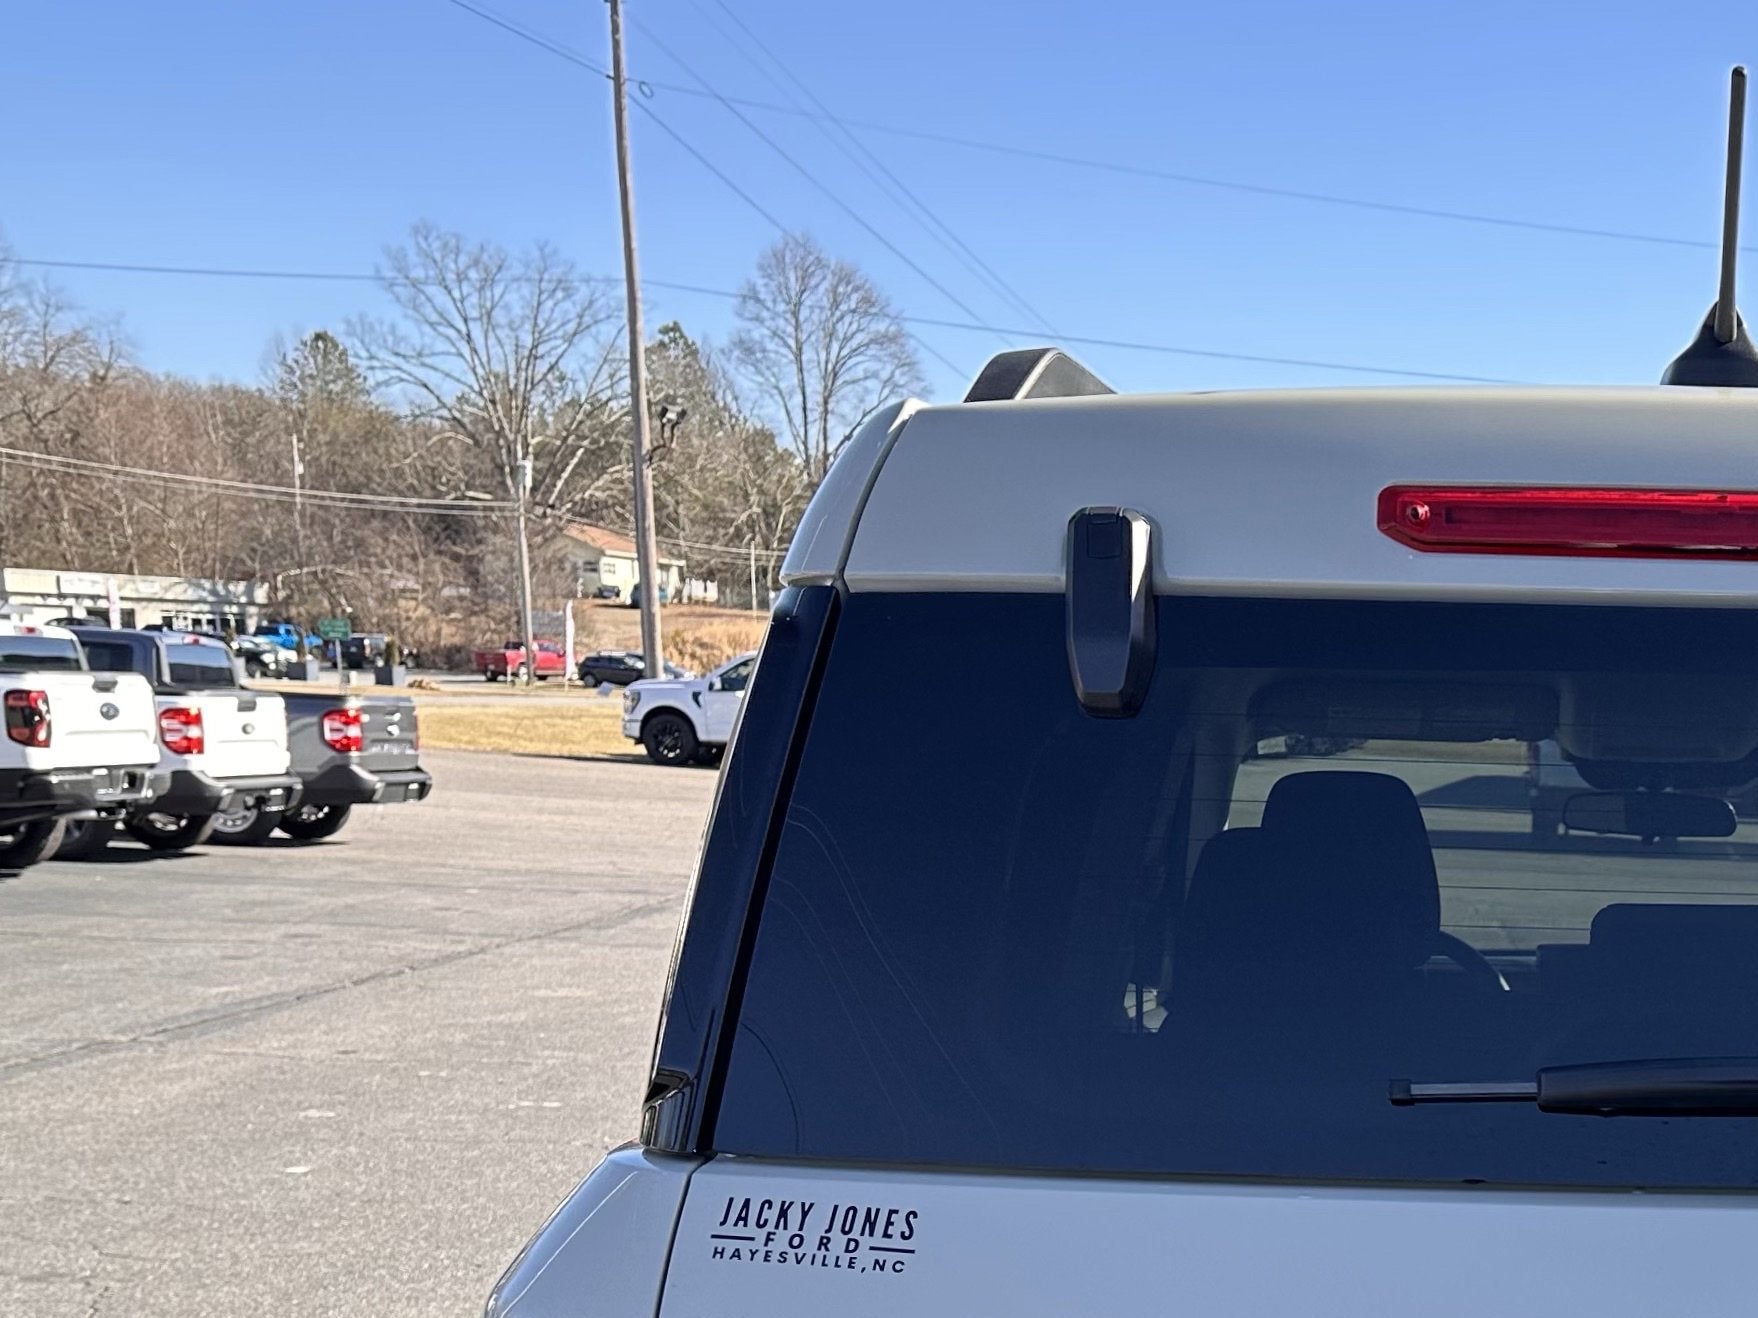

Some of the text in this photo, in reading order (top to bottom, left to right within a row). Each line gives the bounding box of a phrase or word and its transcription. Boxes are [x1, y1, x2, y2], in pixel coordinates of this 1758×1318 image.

[718, 1196, 919, 1241] JACKY JONES
[763, 1231, 860, 1255] FORD
